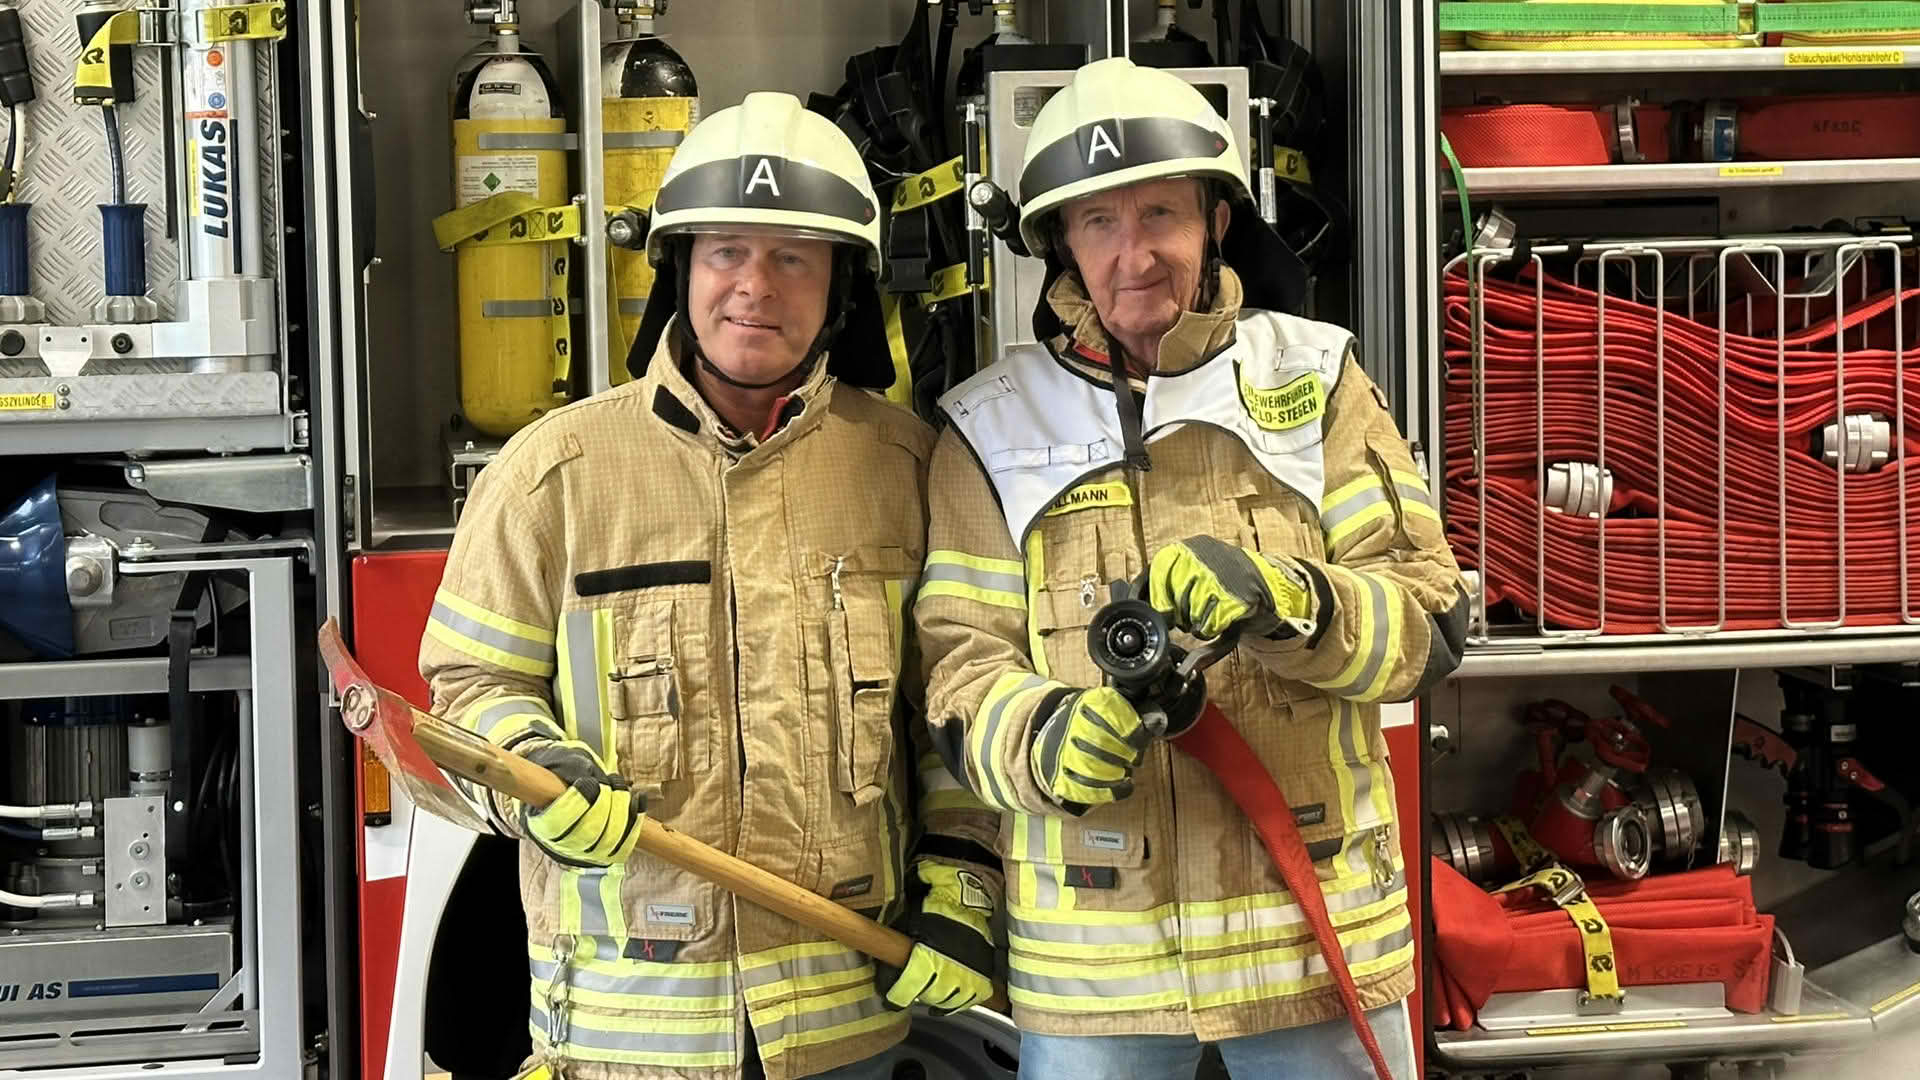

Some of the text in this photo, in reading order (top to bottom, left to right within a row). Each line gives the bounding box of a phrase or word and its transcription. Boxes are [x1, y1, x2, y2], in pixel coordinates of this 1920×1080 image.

[1088, 124, 1121, 164] A
[200, 119, 228, 238] LUKAS
[745, 158, 780, 196] A
